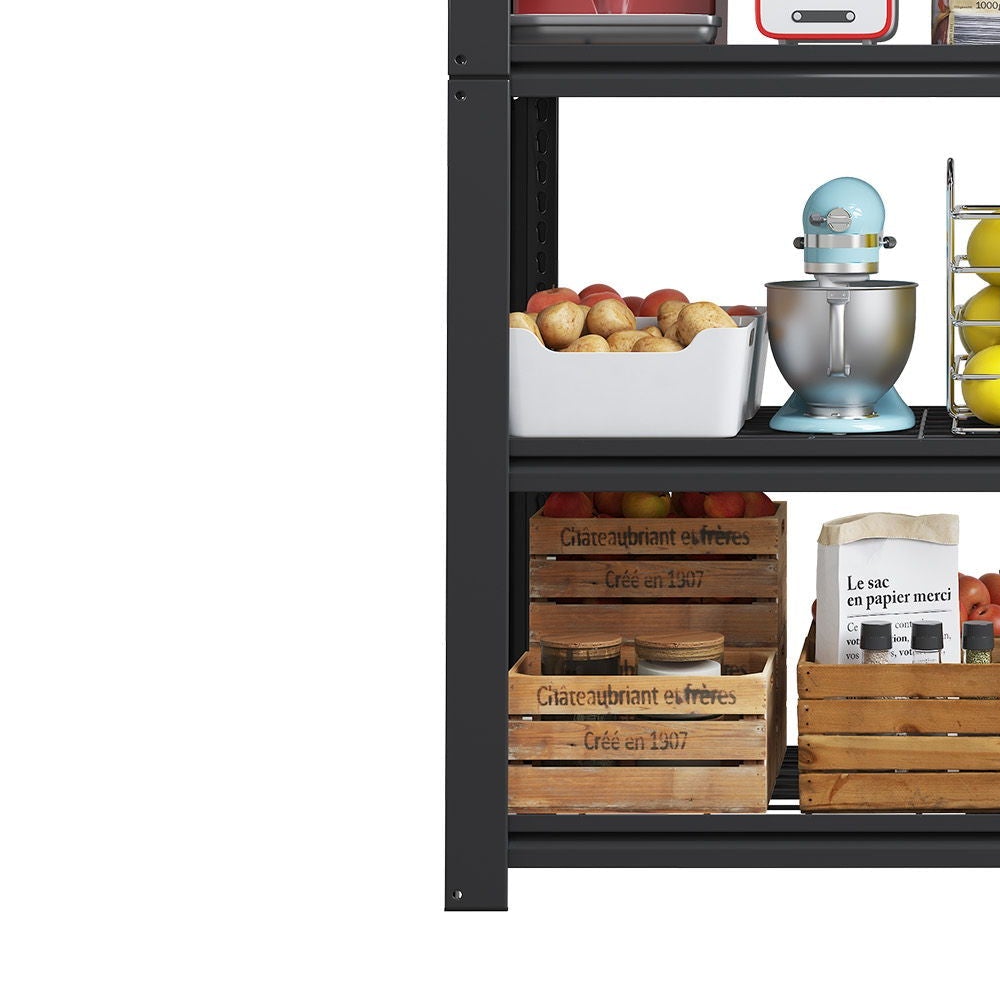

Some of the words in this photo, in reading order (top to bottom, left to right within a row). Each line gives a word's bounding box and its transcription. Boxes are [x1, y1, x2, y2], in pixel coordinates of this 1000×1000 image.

[560, 526, 676, 548] Châteaubriant
[700, 525, 750, 546] frères
[605, 569, 639, 589] Créé
[644, 575, 663, 589] en
[667, 571, 704, 589] 1907
[847, 575, 864, 591] Le
[868, 578, 890, 589] sac
[847, 596, 863, 606] en
[866, 590, 910, 610] papier
[913, 587, 951, 602] merci
[847, 622, 858, 632] Ce
[893, 634, 909, 643] ion,
[536, 684, 659, 708] Châteaubriant
[684, 683, 736, 705] frères
[584, 730, 620, 750] Créé
[624, 736, 644, 750] en
[650, 731, 688, 750] 1907
